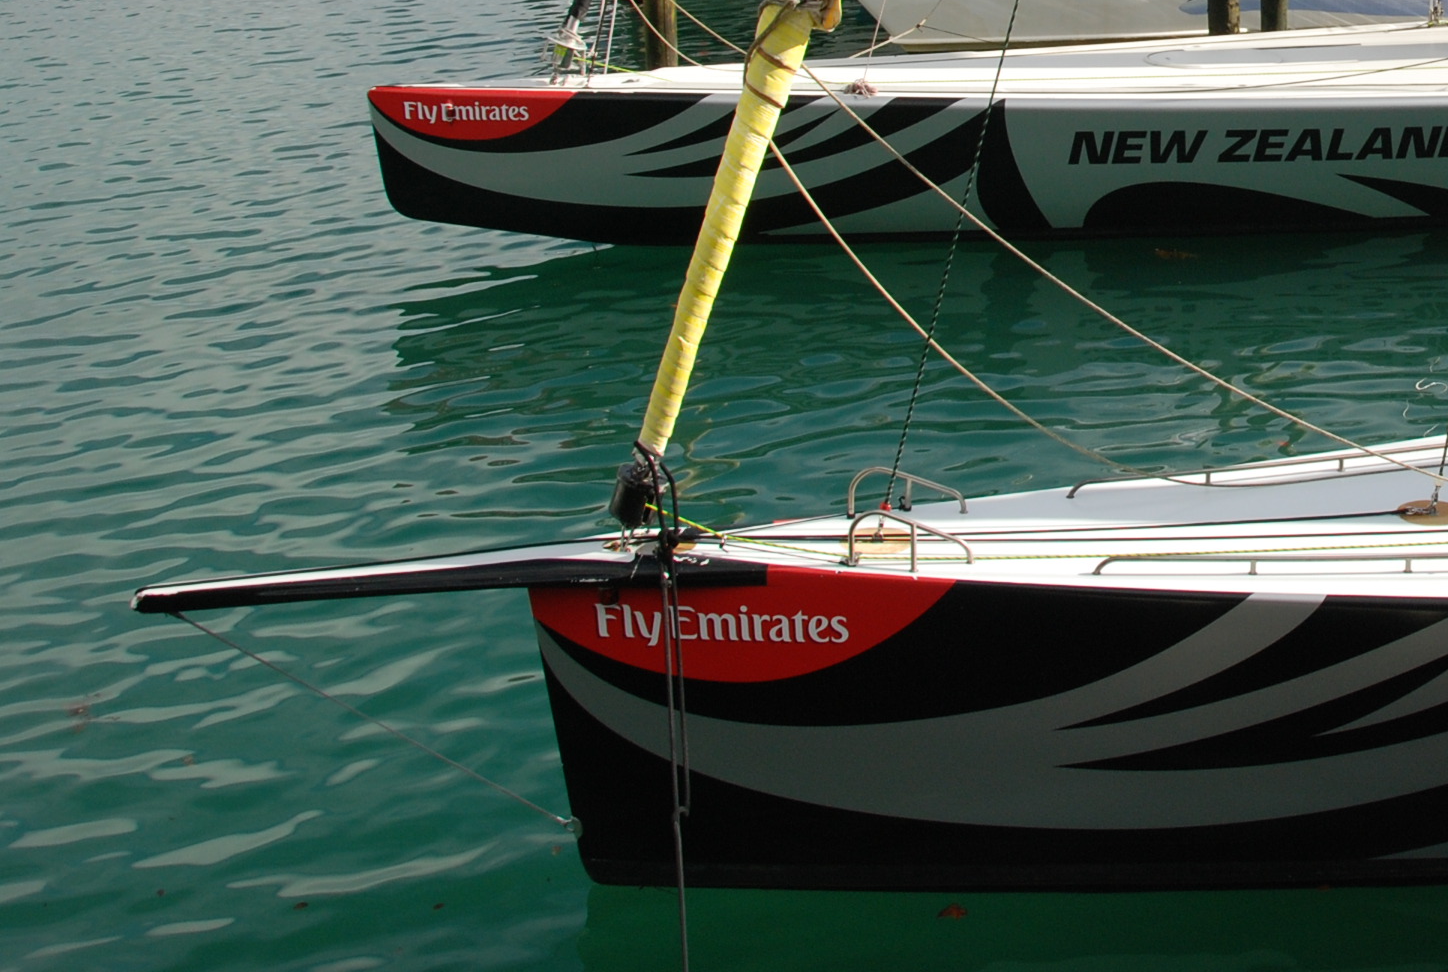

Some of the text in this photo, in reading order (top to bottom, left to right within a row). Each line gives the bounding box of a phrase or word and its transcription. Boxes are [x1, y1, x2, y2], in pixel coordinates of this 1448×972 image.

[403, 101, 438, 124] Fly
[1068, 129, 1209, 166] NEW
[595, 603, 850, 646] Fly Emirates
